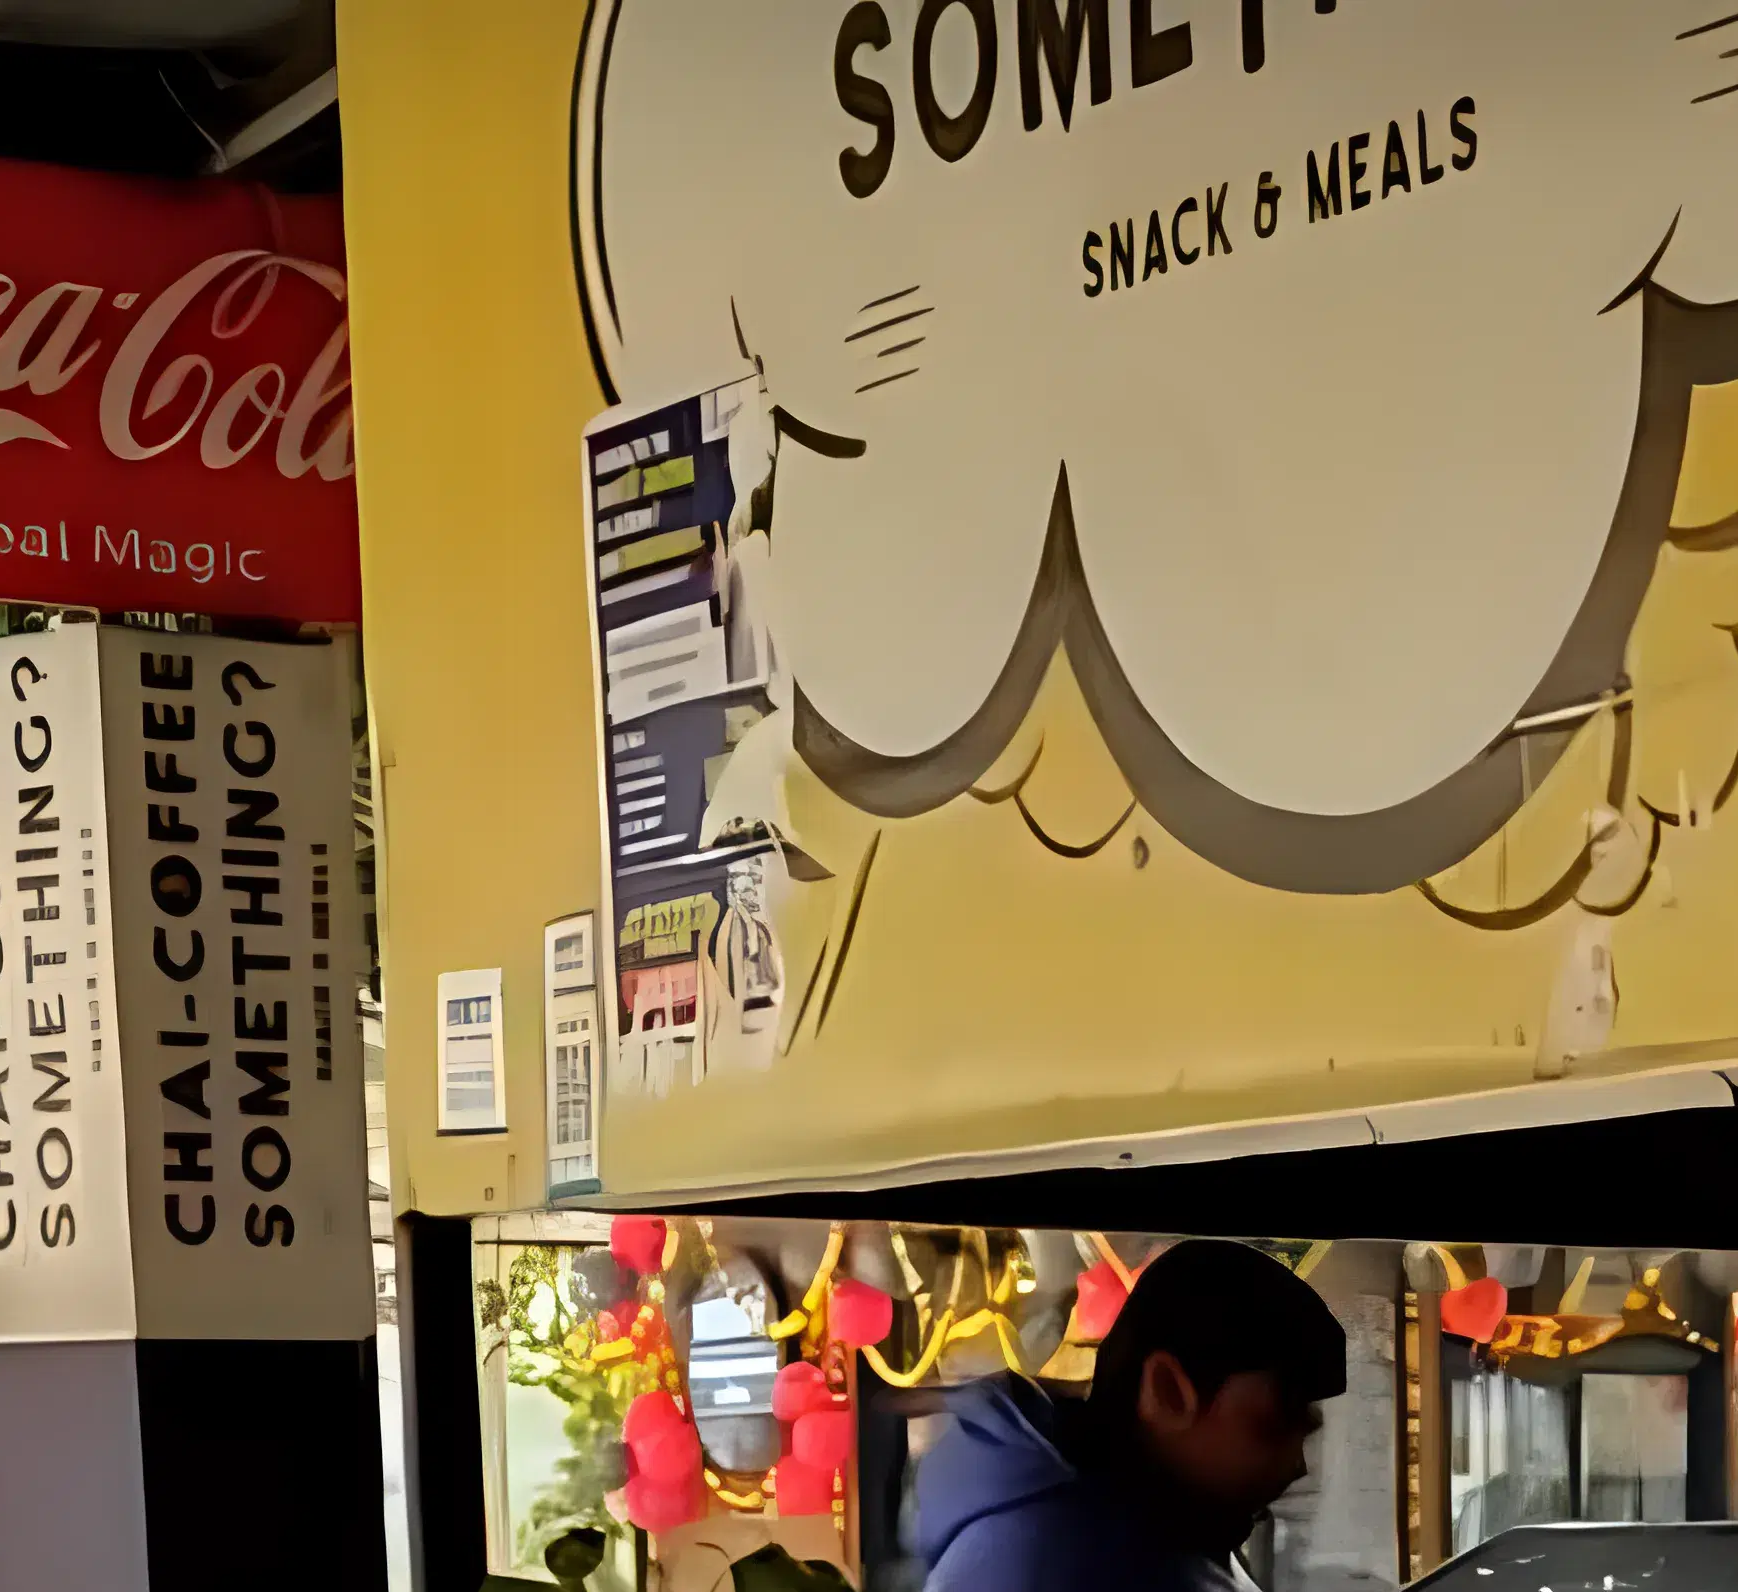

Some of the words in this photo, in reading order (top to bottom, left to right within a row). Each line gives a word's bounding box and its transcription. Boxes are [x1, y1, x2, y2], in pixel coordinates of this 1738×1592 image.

[1082, 181, 1233, 298] SNACK
[1306, 95, 1478, 224] MEALS
[10, 655, 76, 1248] SOMETHING?
[139, 650, 216, 1247] CHAI-COFFEE
[220, 659, 296, 1249] SOMETHING?
